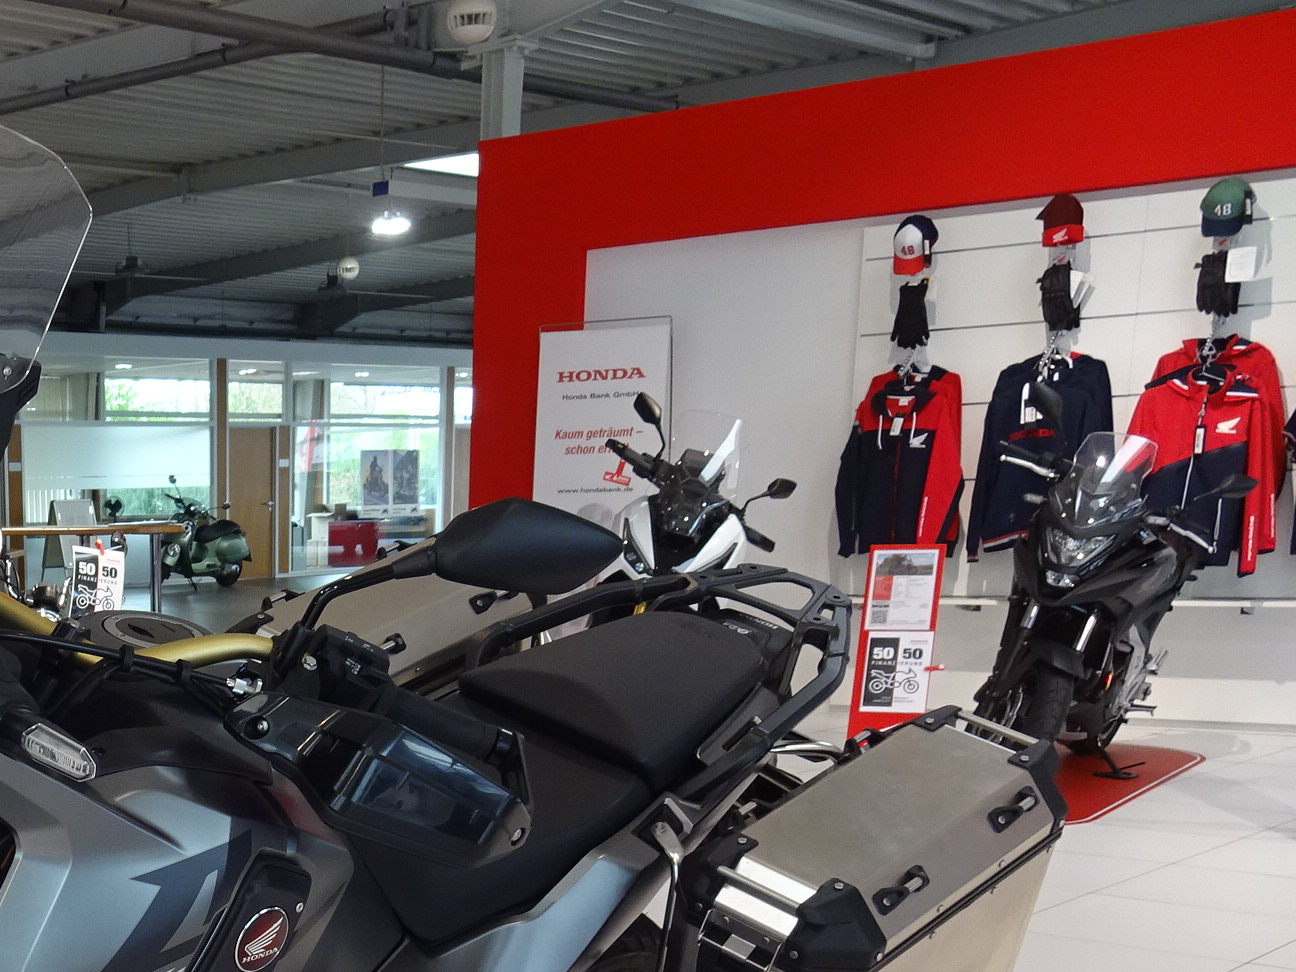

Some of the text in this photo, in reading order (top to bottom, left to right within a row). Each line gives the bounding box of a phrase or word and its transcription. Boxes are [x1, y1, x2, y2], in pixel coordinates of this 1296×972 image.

[1214, 203, 1232, 217] 48
[900, 245, 916, 256] 48
[557, 366, 647, 383] HONDA
[562, 390, 641, 401] Honda Bank GmbH
[554, 428, 584, 440] Kaum
[586, 426, 635, 441] geträumt
[564, 444, 596, 456] schon
[557, 486, 634, 495] www.hondabank.de
[78, 561, 118, 579] 50 50
[77, 574, 118, 586] FINANZIERUNG
[872, 646, 923, 660] 50 50
[241, 946, 279, 964] HONDA
